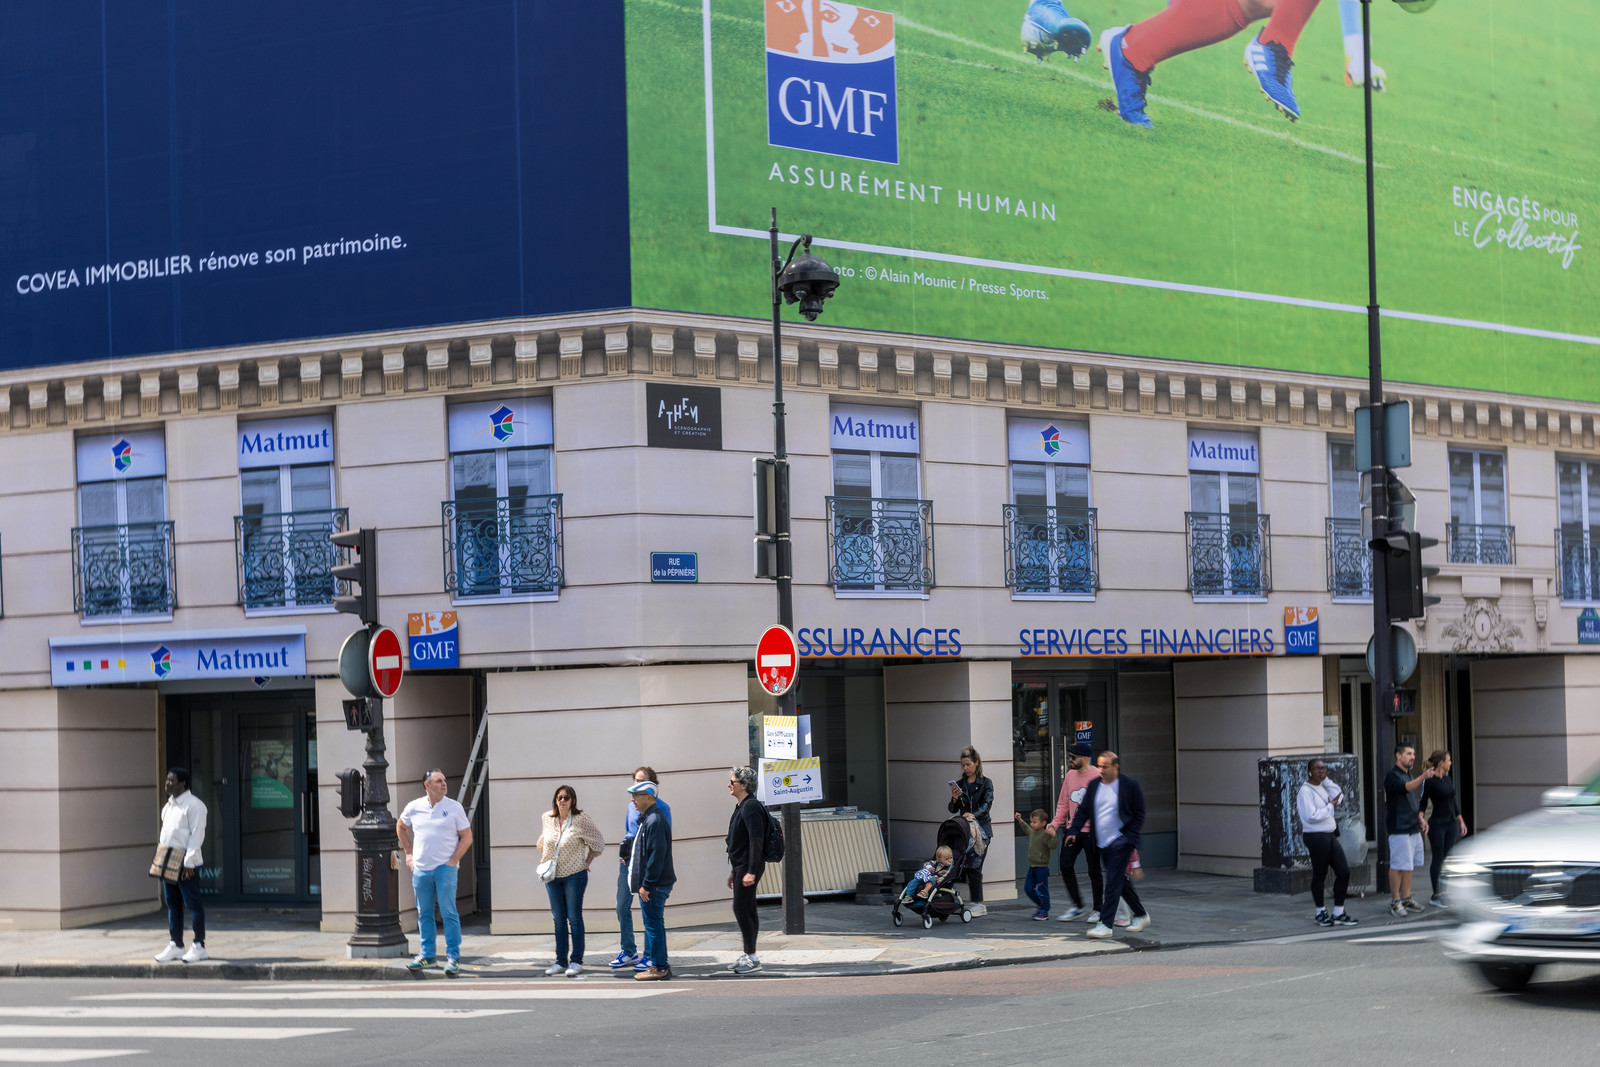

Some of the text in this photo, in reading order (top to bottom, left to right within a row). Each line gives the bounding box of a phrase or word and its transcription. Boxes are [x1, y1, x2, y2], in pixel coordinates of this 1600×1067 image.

[778, 76, 888, 137] GMF
[768, 162, 1056, 222] ASSURÉMENT HUMAIN
[1452, 185, 1579, 229] ENGAGÉS POUR
[1454, 209, 1583, 270] LE Collectif
[16, 233, 408, 295] COVEA IMMOBILIER rénove son patrimoine.
[833, 266, 855, 278] oto
[879, 267, 910, 284] Alain
[913, 271, 957, 290] Mounic
[969, 278, 1006, 296] Presse
[1009, 283, 1050, 301] Sports.
[658, 397, 698, 430] ATHEM
[241, 428, 330, 454] Matmut
[833, 415, 917, 441] Matmut
[1189, 439, 1257, 463] Matmut
[653, 568, 661, 577] de
[661, 568, 667, 577] la
[668, 557, 681, 566] RUE
[413, 640, 455, 661] GMF
[797, 627, 962, 657] SSURANCES
[1019, 627, 1275, 656] SERVICES FINANCIERS
[1288, 630, 1317, 648] GMF
[197, 646, 289, 671] Matmut
[1077, 731, 1092, 740] GMF
[773, 786, 814, 796] Saint-Augustin
